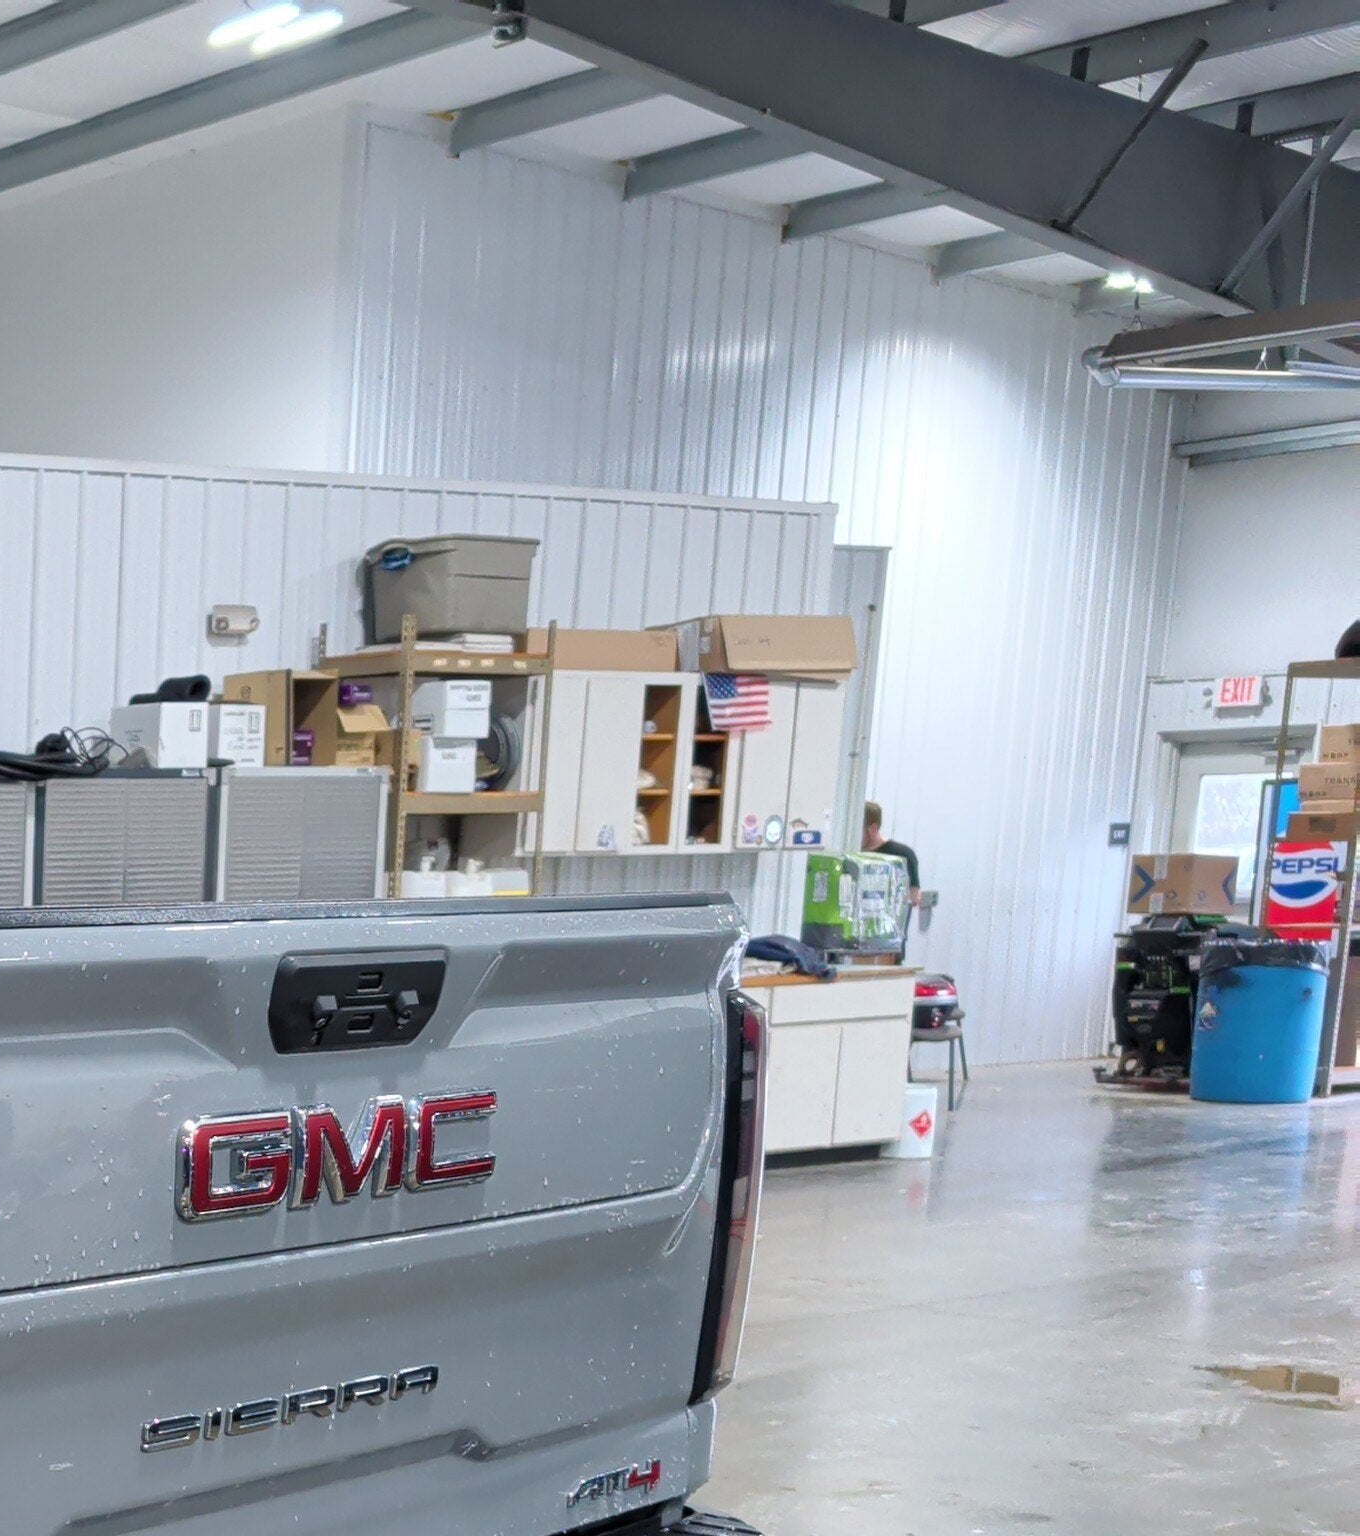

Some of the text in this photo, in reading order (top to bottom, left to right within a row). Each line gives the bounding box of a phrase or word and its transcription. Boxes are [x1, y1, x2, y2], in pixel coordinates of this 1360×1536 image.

[1220, 677, 1256, 702] EXIT
[175, 1089, 497, 1222] GMC
[140, 1364, 439, 1453] SIERRA
[567, 1458, 661, 1508] AT4
